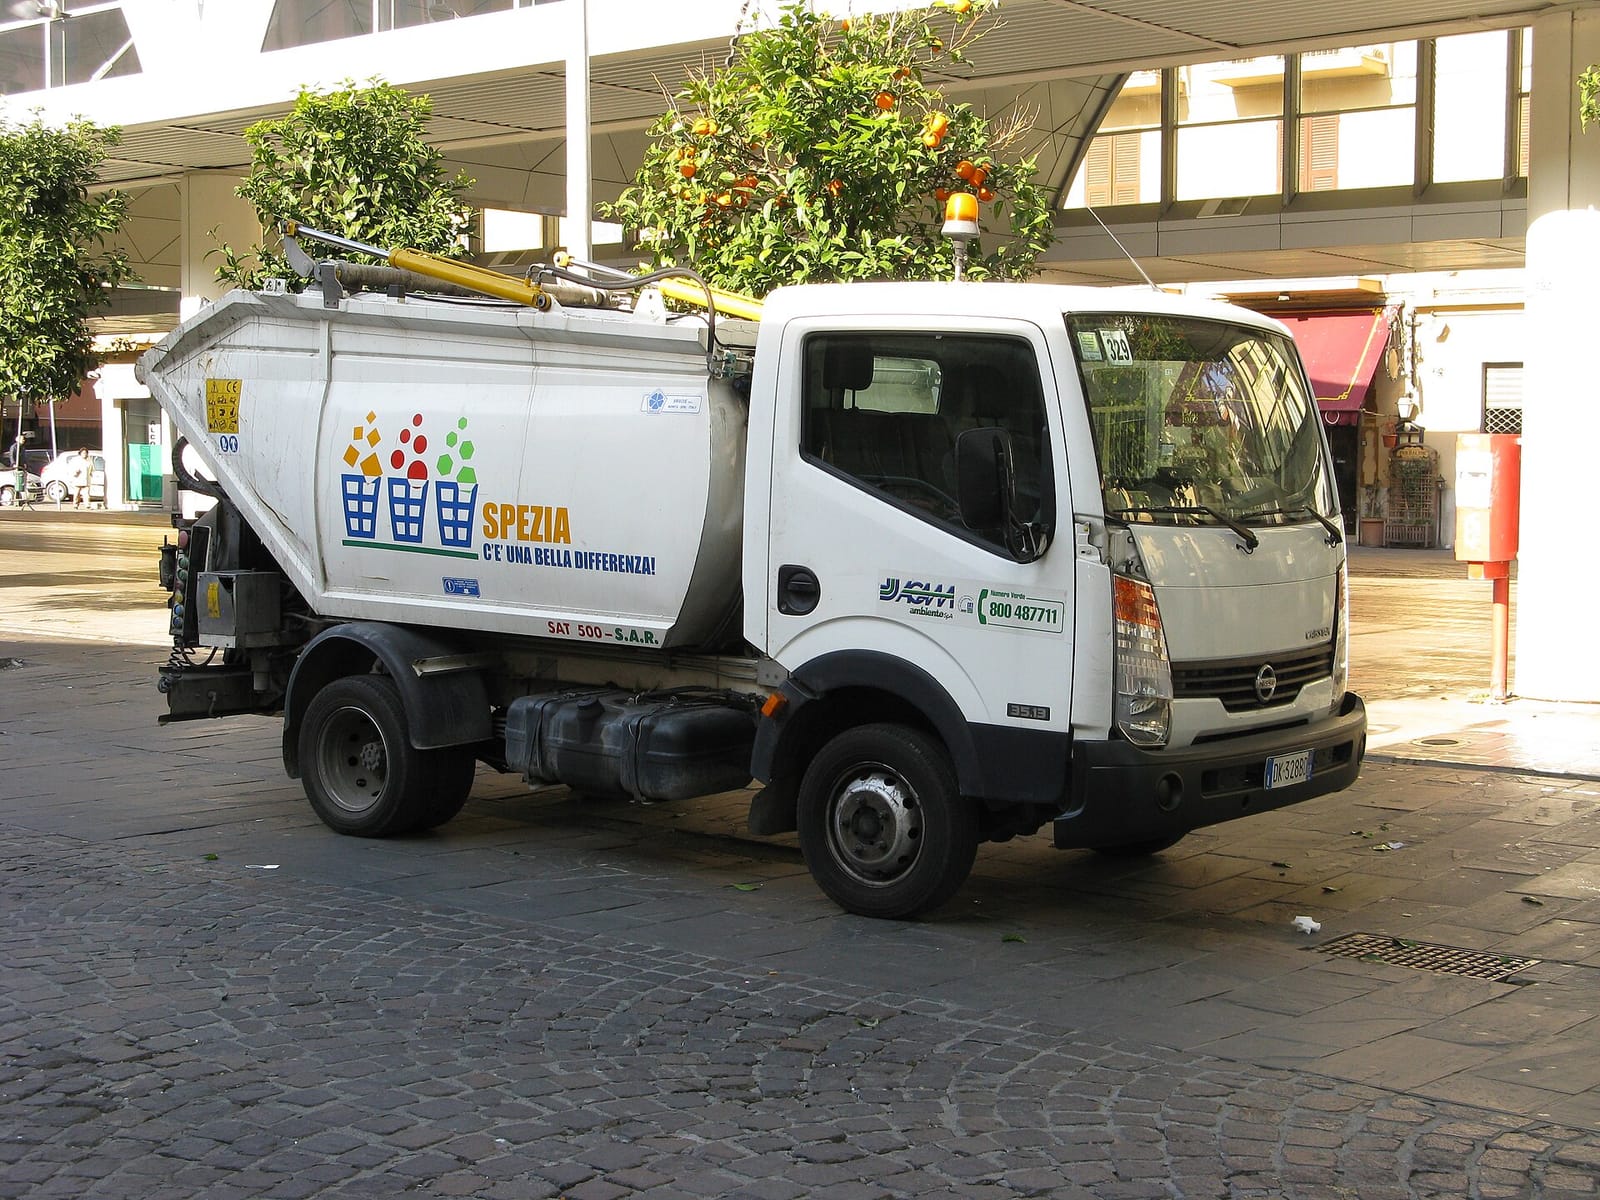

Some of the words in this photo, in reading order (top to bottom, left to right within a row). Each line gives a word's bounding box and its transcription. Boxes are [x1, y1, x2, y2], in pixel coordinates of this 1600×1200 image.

[1107, 338, 1130, 361] 329
[482, 502, 571, 545] SPEZIA
[506, 545, 532, 565] UNA
[535, 547, 572, 568] BELLA
[575, 551, 656, 575] DIFFERENZA!
[989, 602, 1012, 618] 800
[1014, 605, 1057, 624] 487711
[547, 621, 570, 635] SAT
